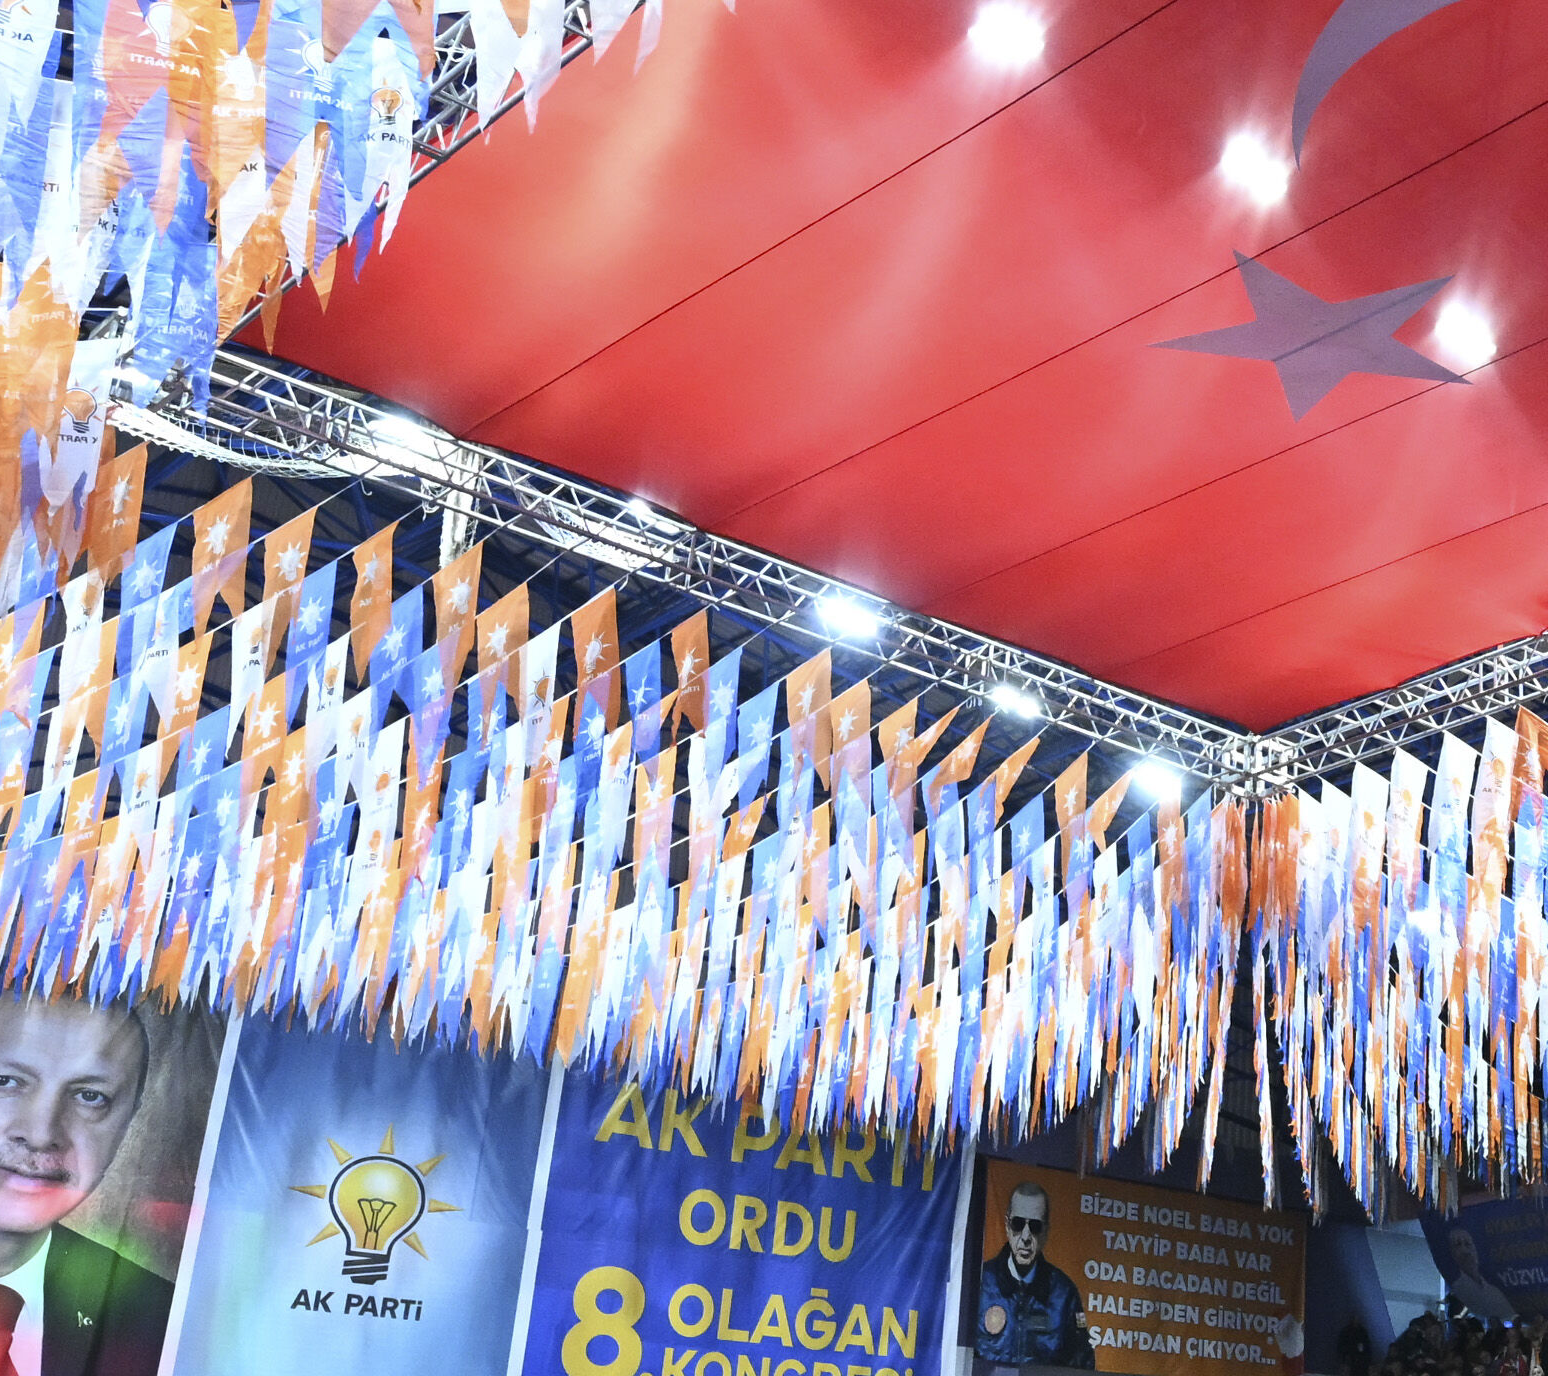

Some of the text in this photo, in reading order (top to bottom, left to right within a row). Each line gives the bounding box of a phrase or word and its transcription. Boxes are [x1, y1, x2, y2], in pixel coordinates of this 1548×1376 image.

[594, 1082, 708, 1158] AK
[678, 1188, 857, 1263] ORDU
[1080, 1192, 1294, 1246] BİZDE NOEL BABA YOK
[1102, 1230, 1272, 1273] TAYYİP BABA VAR
[290, 1289, 335, 1313] AK
[1084, 1259, 1286, 1305] ODA BACADAN DEĞİL
[668, 1283, 919, 1359] OLAĞAN
